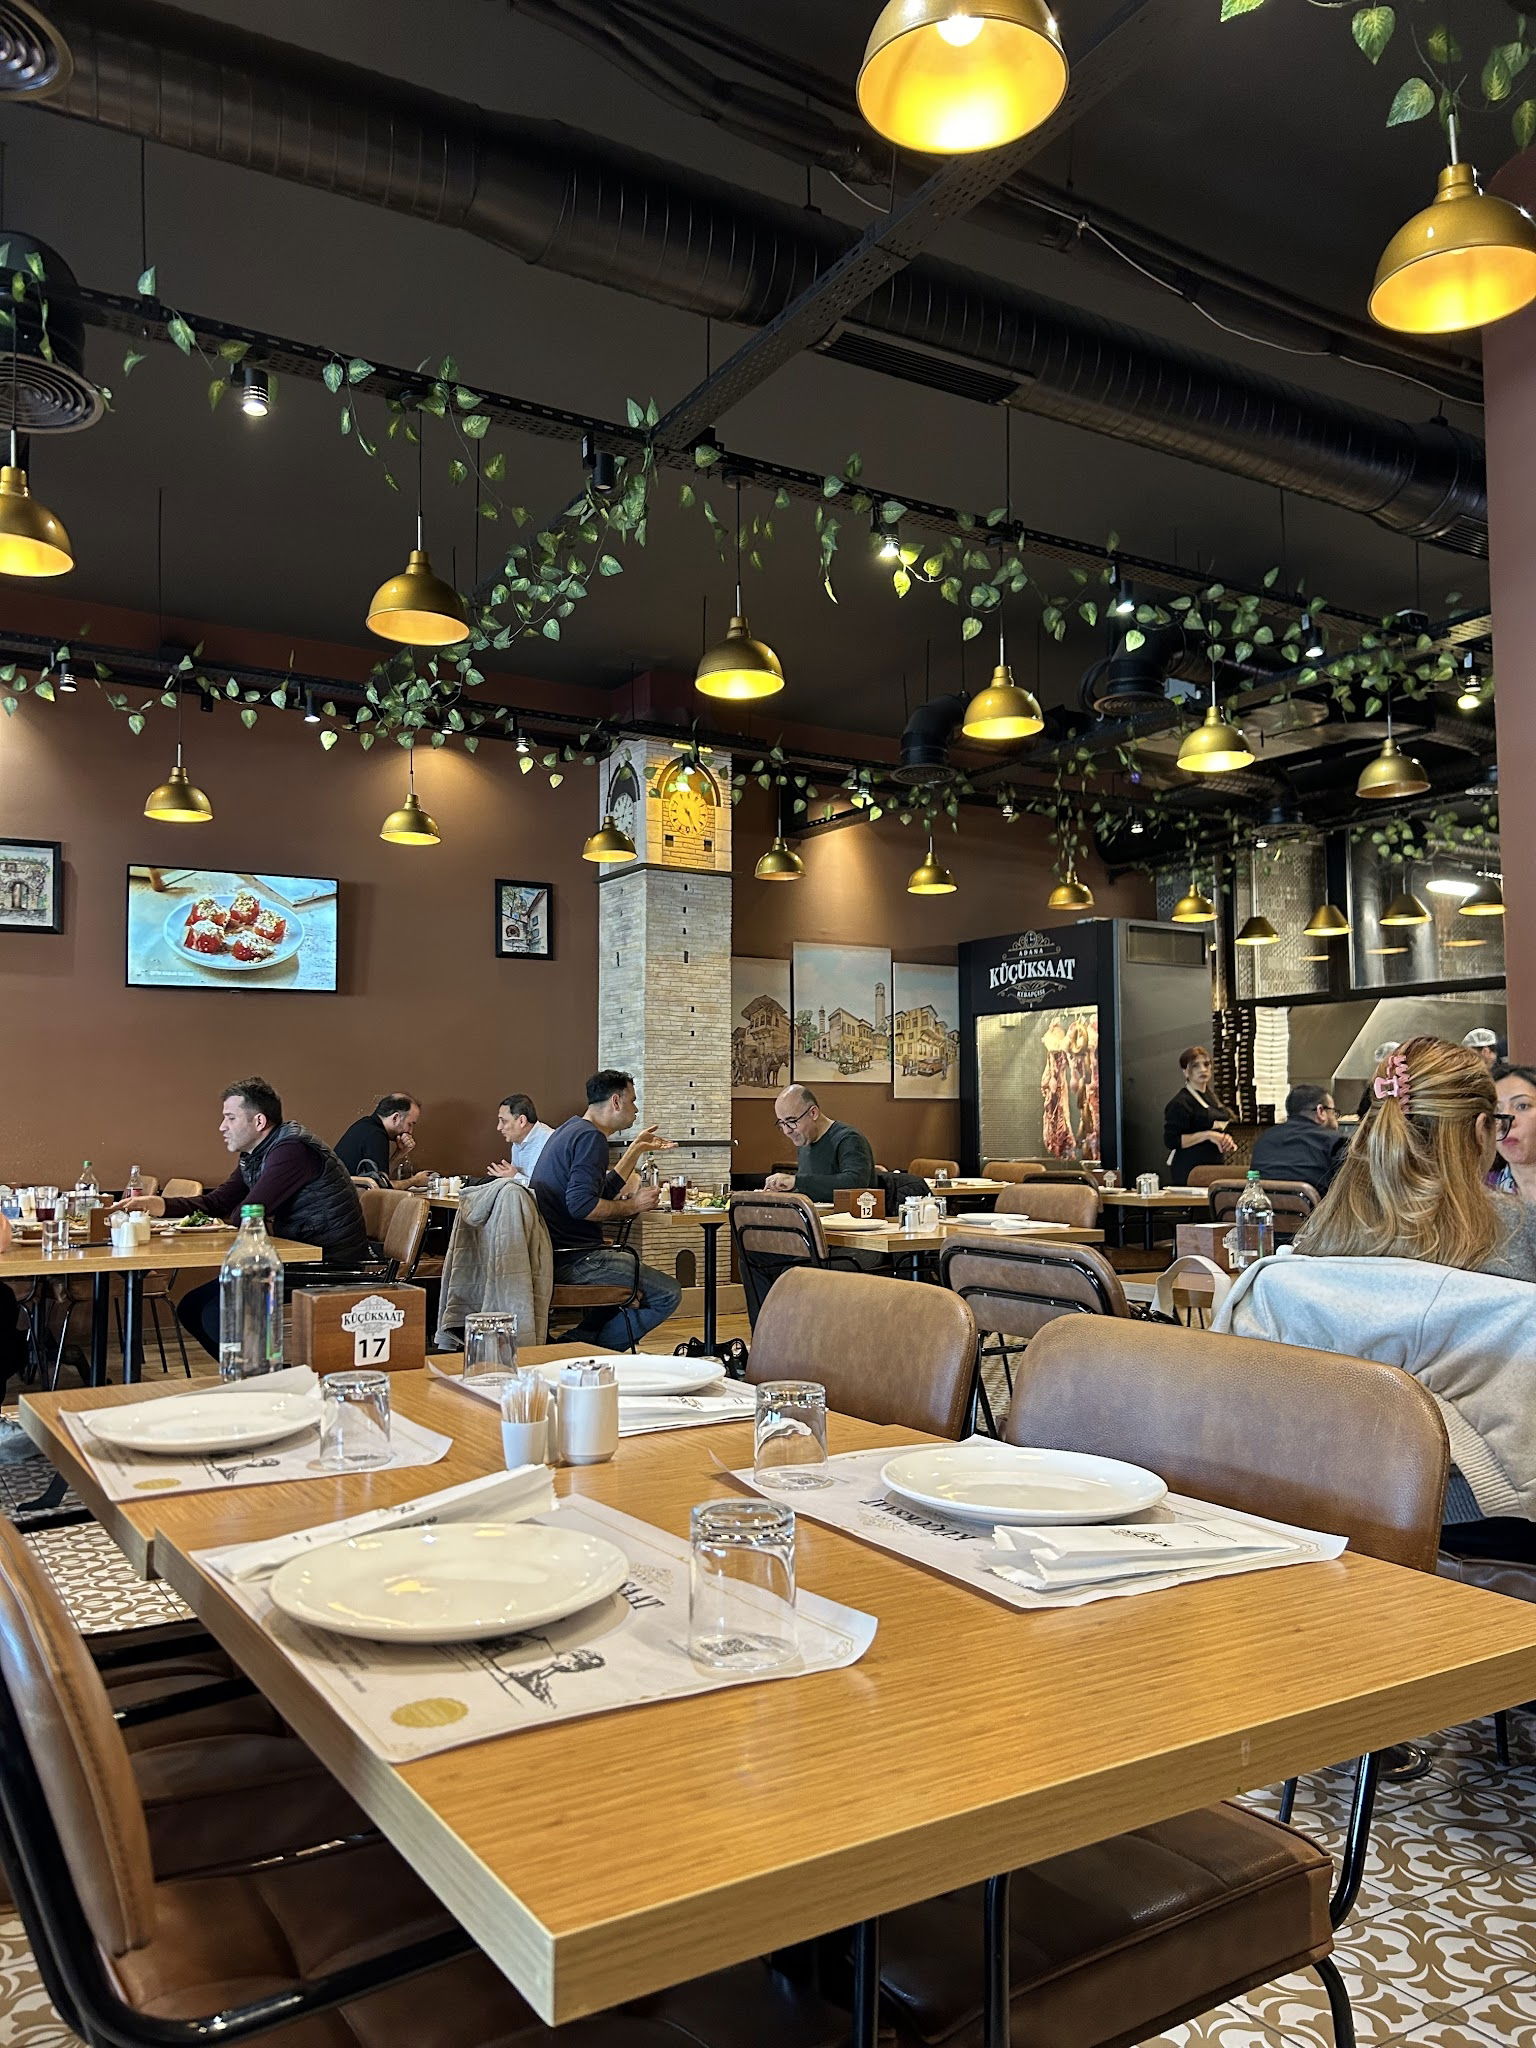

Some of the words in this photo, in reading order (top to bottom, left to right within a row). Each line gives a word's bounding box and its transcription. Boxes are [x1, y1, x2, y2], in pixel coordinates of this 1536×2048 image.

[989, 958, 1076, 990] KÜÇÜKSAAT
[862, 1207, 871, 1216] 12
[344, 1311, 403, 1326] KÜÇÜKSAAT
[359, 1337, 386, 1359] 17
